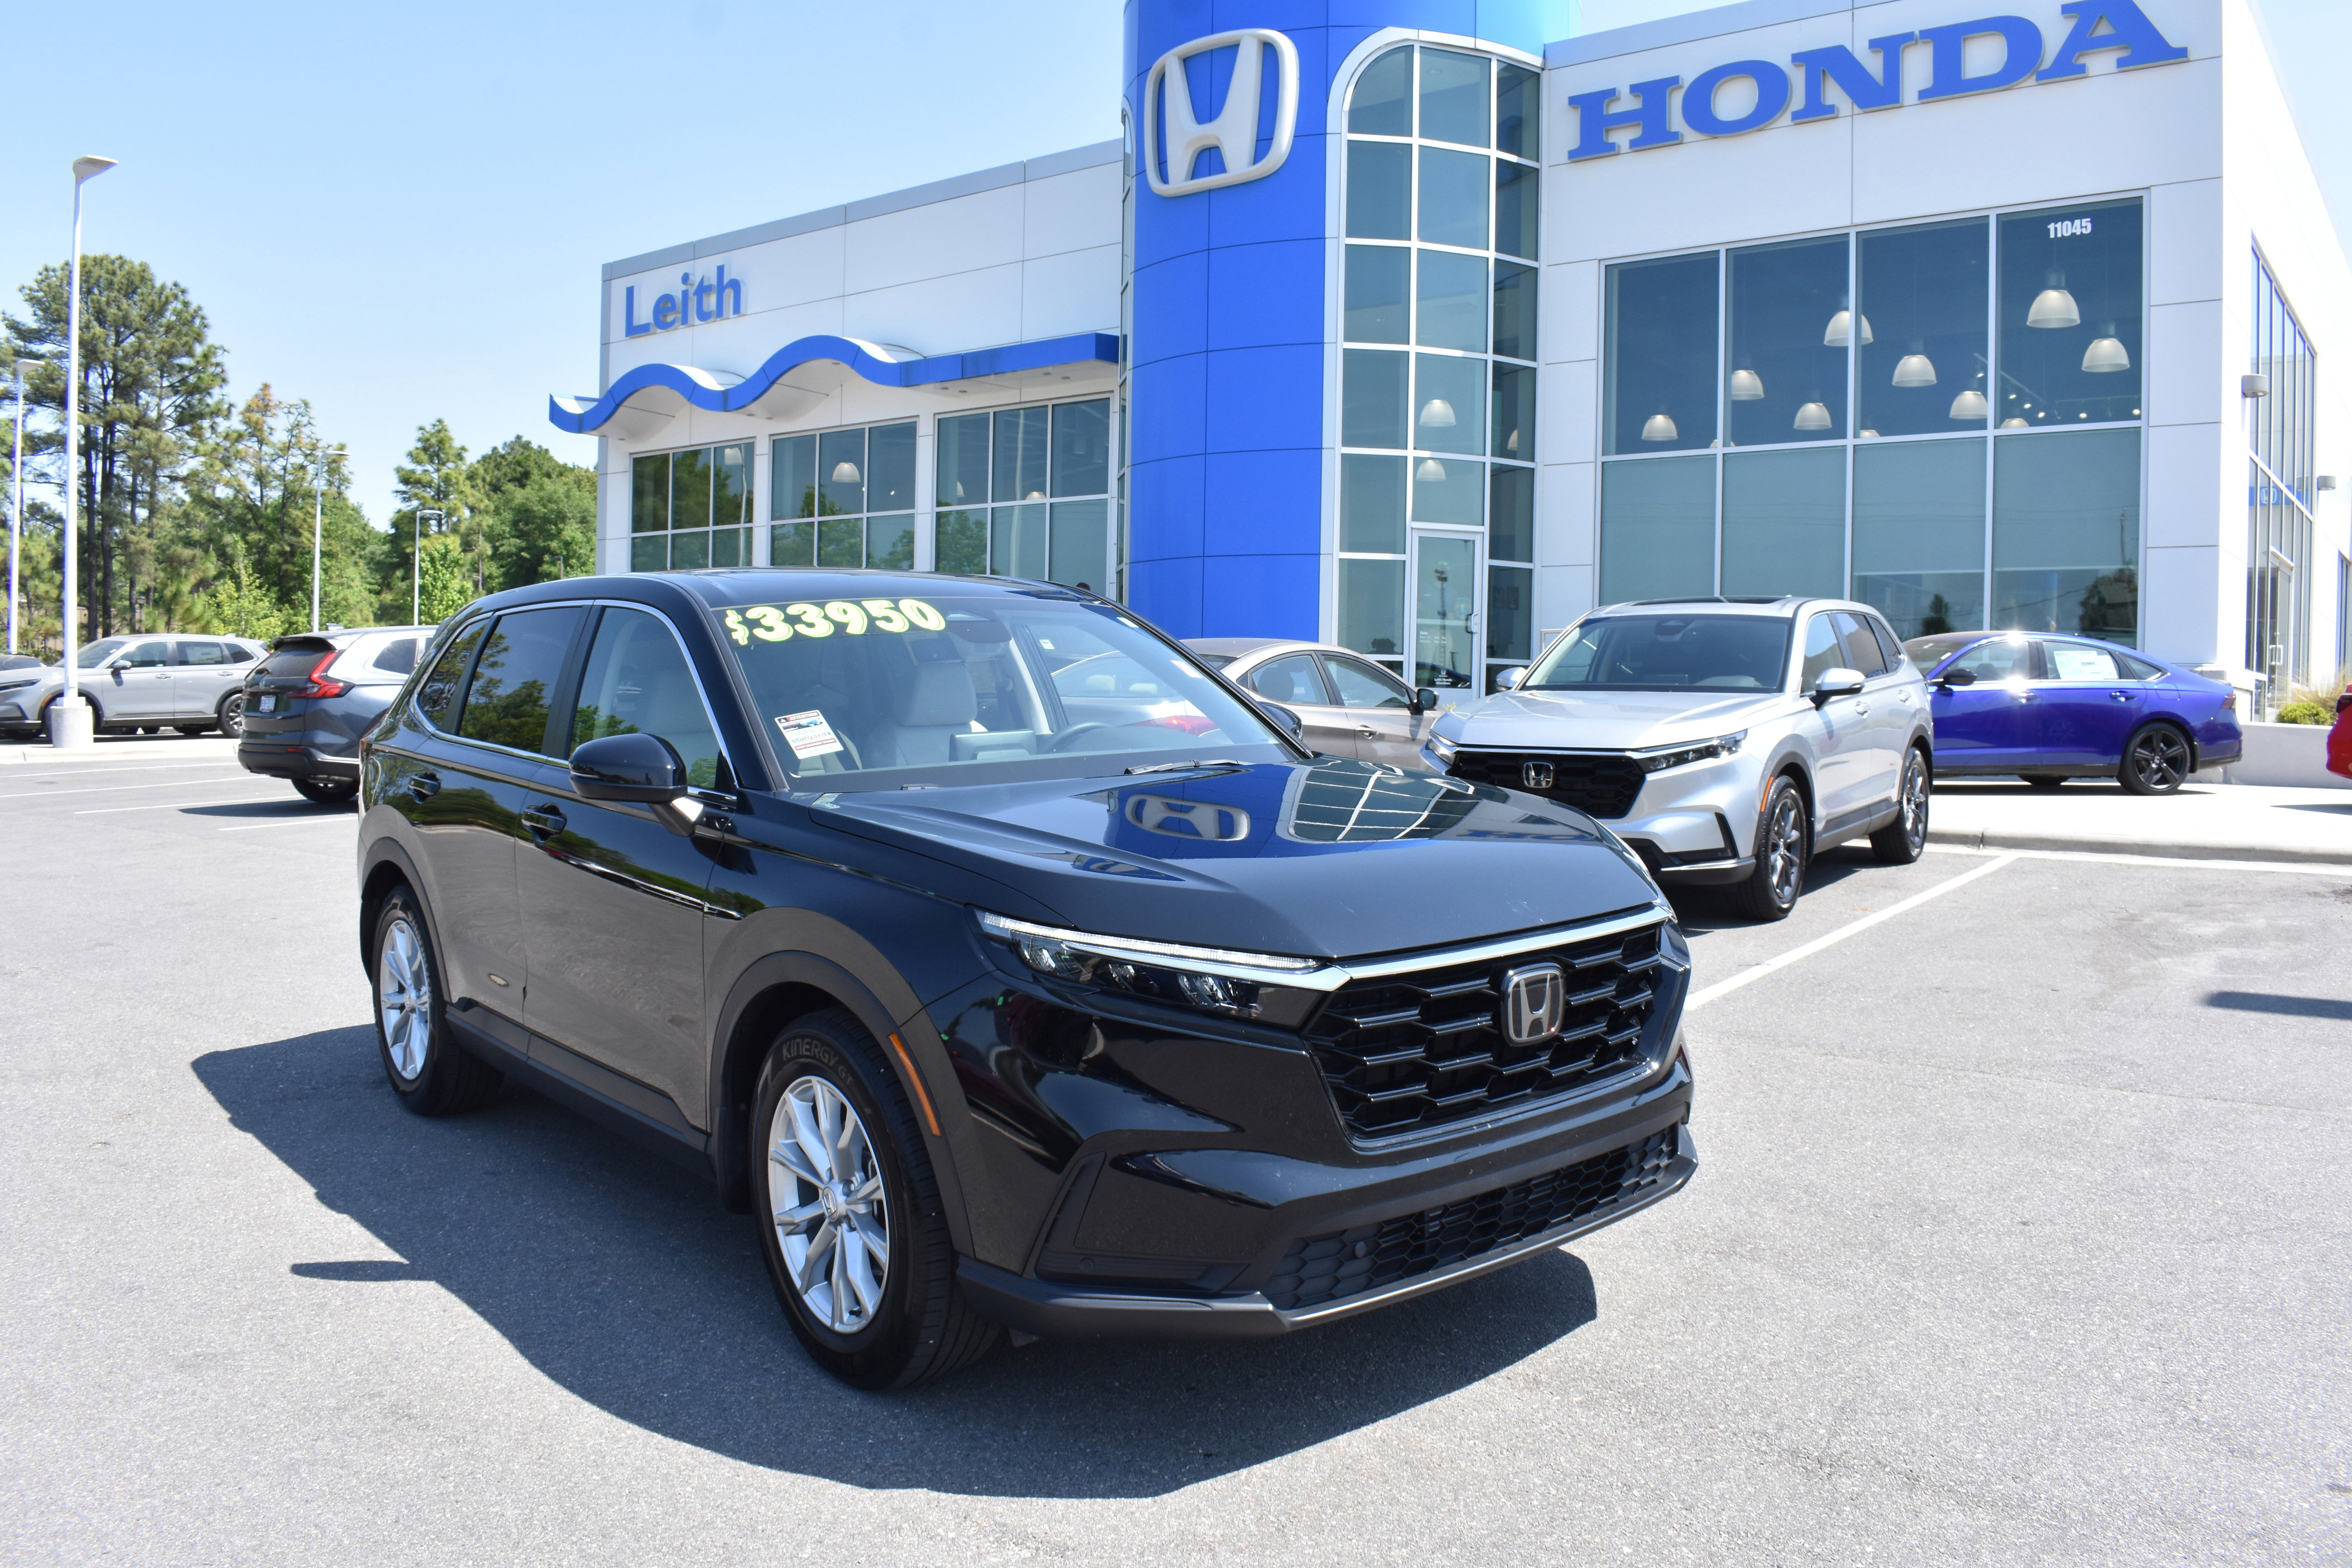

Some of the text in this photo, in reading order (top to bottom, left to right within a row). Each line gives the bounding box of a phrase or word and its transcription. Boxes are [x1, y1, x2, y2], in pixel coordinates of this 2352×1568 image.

[1568, 0, 2189, 162] HONDA
[2047, 218, 2091, 238] 11045
[625, 264, 743, 338] Leith
[725, 599, 946, 645] $33950
[790, 712, 819, 721] ATTENTION
[782, 1038, 839, 1067] KINERGY
